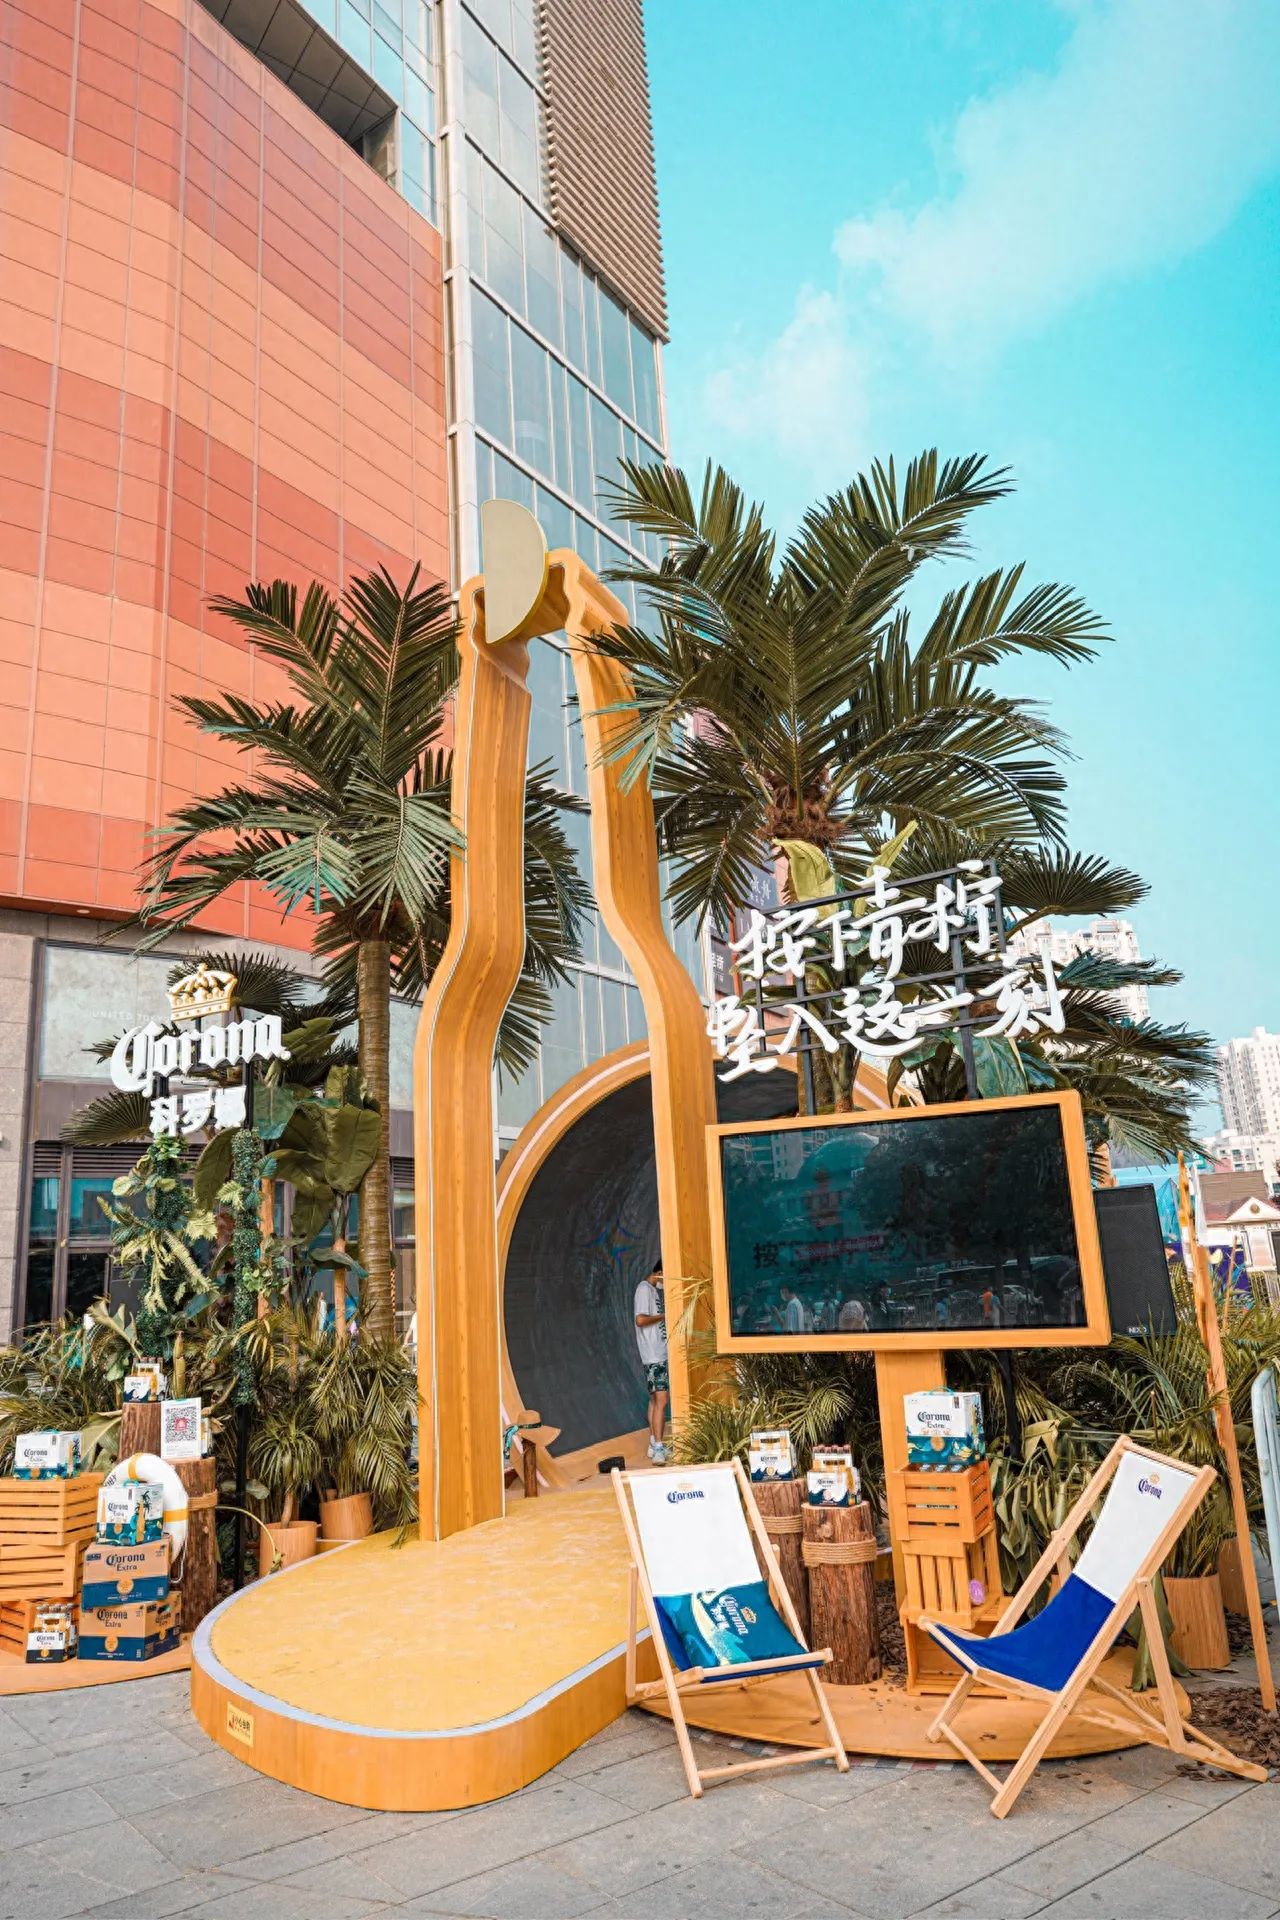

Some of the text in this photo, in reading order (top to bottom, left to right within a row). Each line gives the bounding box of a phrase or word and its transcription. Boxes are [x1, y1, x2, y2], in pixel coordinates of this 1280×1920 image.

[110, 1014, 292, 1098] Corona
[917, 1411, 951, 1423] Corona
[23, 1448, 48, 1457] Corona
[1138, 1478, 1163, 1500] Corona
[667, 1489, 704, 1504] Corona
[105, 1553, 145, 1566] Corona
[116, 1563, 138, 1572] Extra
[96, 1608, 128, 1621] Corona
[718, 1594, 749, 1636] Corona
